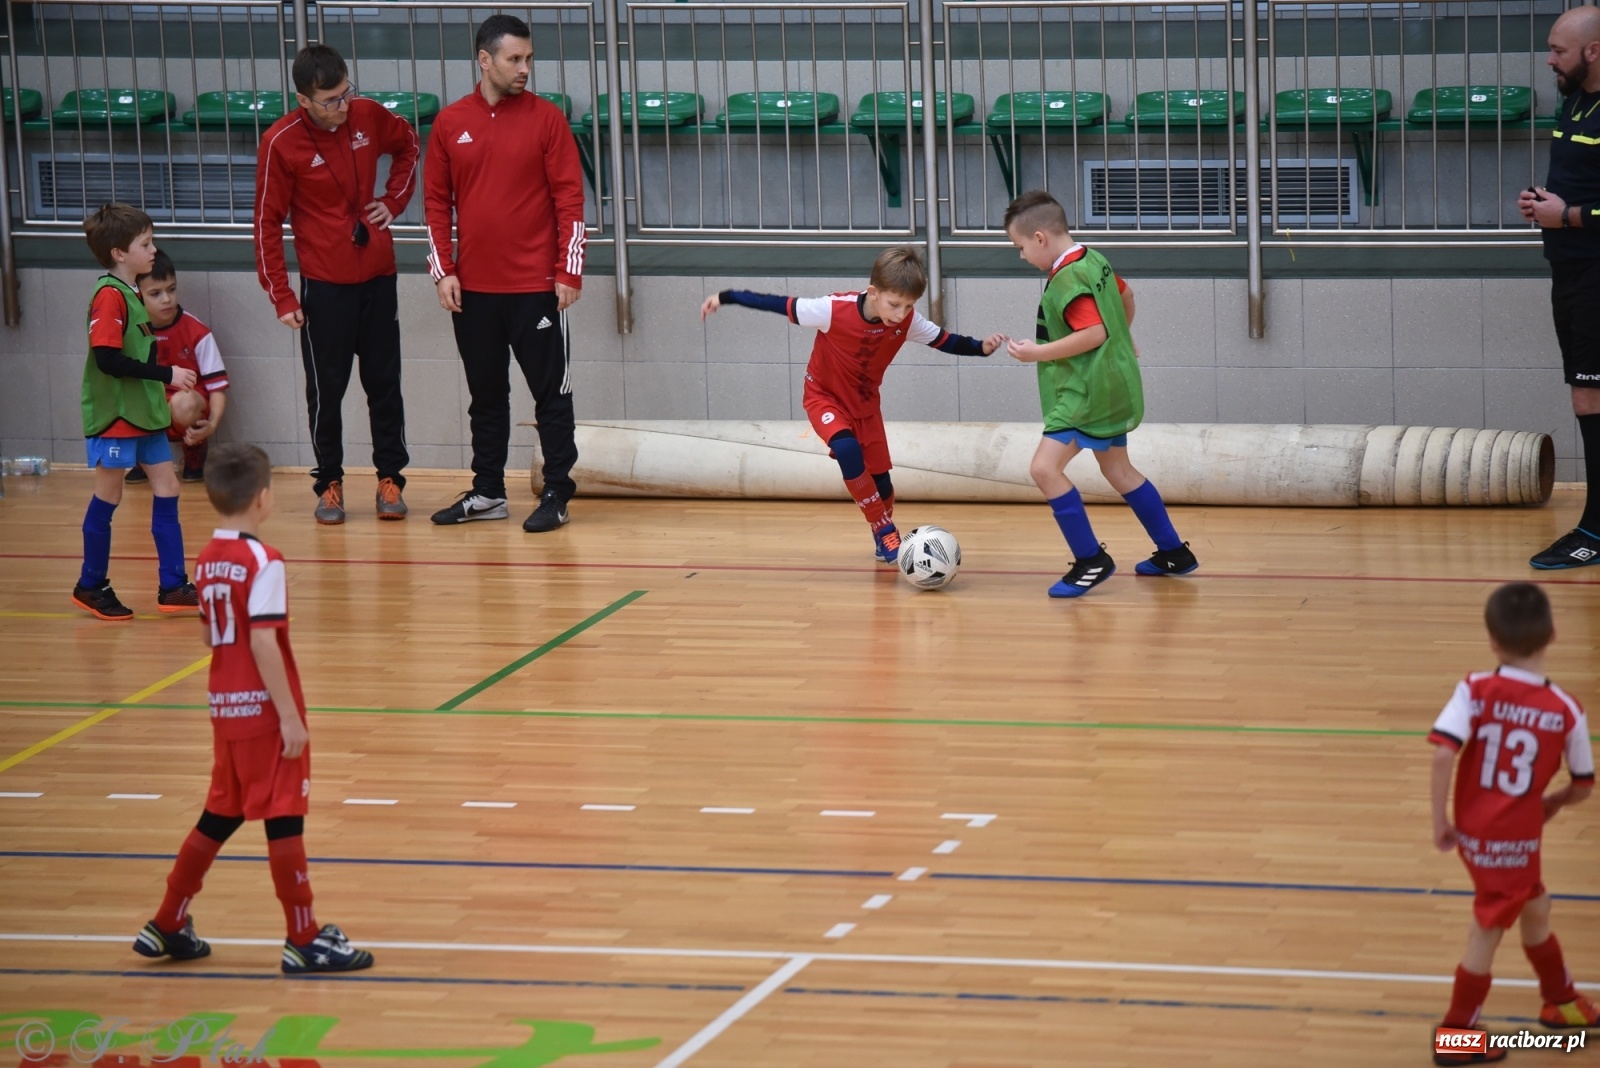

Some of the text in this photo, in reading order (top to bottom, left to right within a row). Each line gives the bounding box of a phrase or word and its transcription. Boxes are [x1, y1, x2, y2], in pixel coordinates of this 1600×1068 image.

[821, 411, 835, 425] 9
[202, 583, 236, 646] 17
[1477, 723, 1539, 797] 13
